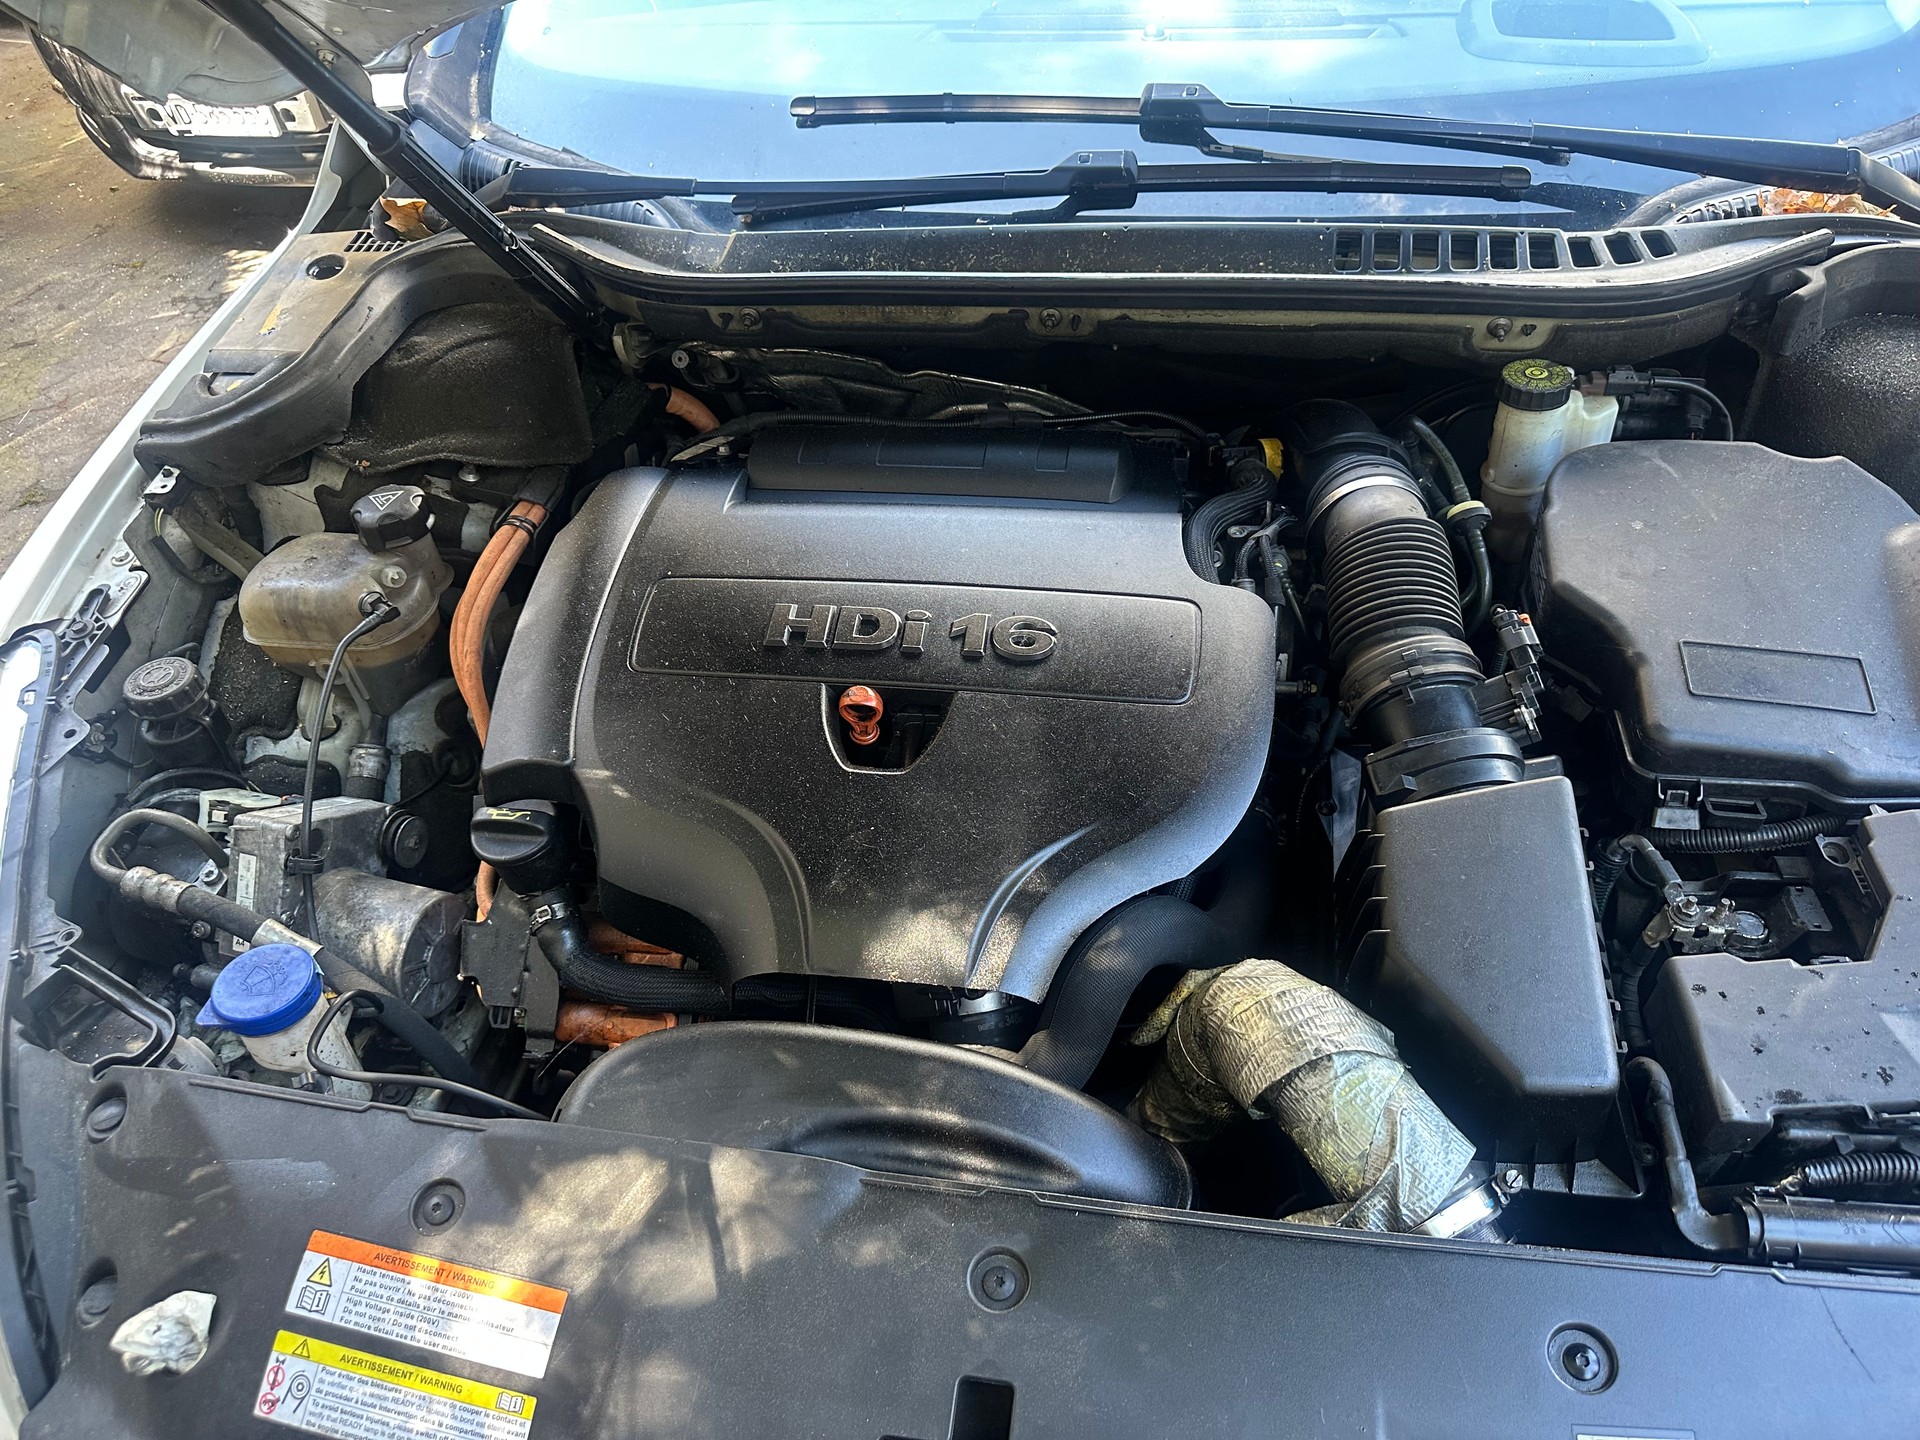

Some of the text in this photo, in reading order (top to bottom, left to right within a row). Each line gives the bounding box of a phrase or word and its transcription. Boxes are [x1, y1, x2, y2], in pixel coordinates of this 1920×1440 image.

[763, 604, 1059, 660] HDi 16
[353, 1275, 362, 1284] Ne
[364, 1279, 378, 1289] pas
[379, 1283, 401, 1295] ouvrir
[407, 1289, 416, 1298] Ne
[417, 1292, 431, 1302] pas
[357, 1265, 378, 1276] Haute
[379, 1270, 405, 1284] tension
[450, 1289, 474, 1302] (200V)
[373, 1252, 446, 1279] AVERTISSEMENT
[452, 1271, 495, 1289] WARNING
[346, 1296, 440, 1328] High Voltage inside (200V)
[350, 1285, 367, 1296] Pour
[368, 1289, 384, 1301] plus
[386, 1293, 394, 1303] de
[396, 1296, 421, 1310] détails
[423, 1303, 437, 1314] voir
[438, 1307, 446, 1316] le
[339, 1316, 352, 1324] For
[353, 1320, 372, 1330] more
[374, 1324, 394, 1337] detail
[395, 1332, 408, 1340] see
[410, 1333, 421, 1344] the
[423, 1338, 440, 1349] user
[342, 1306, 352, 1314] Do
[354, 1308, 367, 1318] not
[368, 1314, 386, 1325] open
[392, 1318, 402, 1327] Do
[404, 1322, 416, 1332] not
[418, 1326, 459, 1342] disconnect
[340, 1353, 415, 1380] AVERTISSEMENT
[420, 1375, 462, 1394] WARNING
[314, 1386, 324, 1394] de
[324, 1390, 354, 1405] procéder
[360, 1399, 378, 1410] toute
[378, 1404, 418, 1420] intervention
[420, 1416, 436, 1426] dans
[437, 1420, 444, 1429] le
[445, 1422, 492, 1440] compartiment
[318, 1376, 326, 1384] de
[390, 1396, 416, 1410] READY
[416, 1403, 424, 1412] du
[450, 1411, 458, 1420] de
[460, 1414, 476, 1426] bord
[476, 1420, 486, 1430] est
[506, 1428, 526, 1440] avant
[320, 1366, 336, 1377] Pour
[338, 1370, 356, 1381] éviter
[357, 1376, 369, 1386] des
[370, 1378, 402, 1394] blessures
[448, 1400, 458, 1410] de
[458, 1404, 483, 1418] couper
[484, 1409, 490, 1418] le
[492, 1412, 518, 1426] contact
[518, 1420, 527, 1429] et
[306, 1419, 316, 1428] the
[317, 1423, 340, 1434] engine
[311, 1399, 320, 1407] To
[320, 1402, 339, 1412] avoid
[340, 1408, 364, 1420] serious
[392, 1422, 414, 1434] please
[414, 1428, 437, 1440] switch
[326, 1414, 338, 1423] that
[339, 1417, 362, 1430] READY
[364, 1424, 379, 1436] lamp
[380, 1428, 386, 1437] is
[387, 1431, 396, 1440] off
